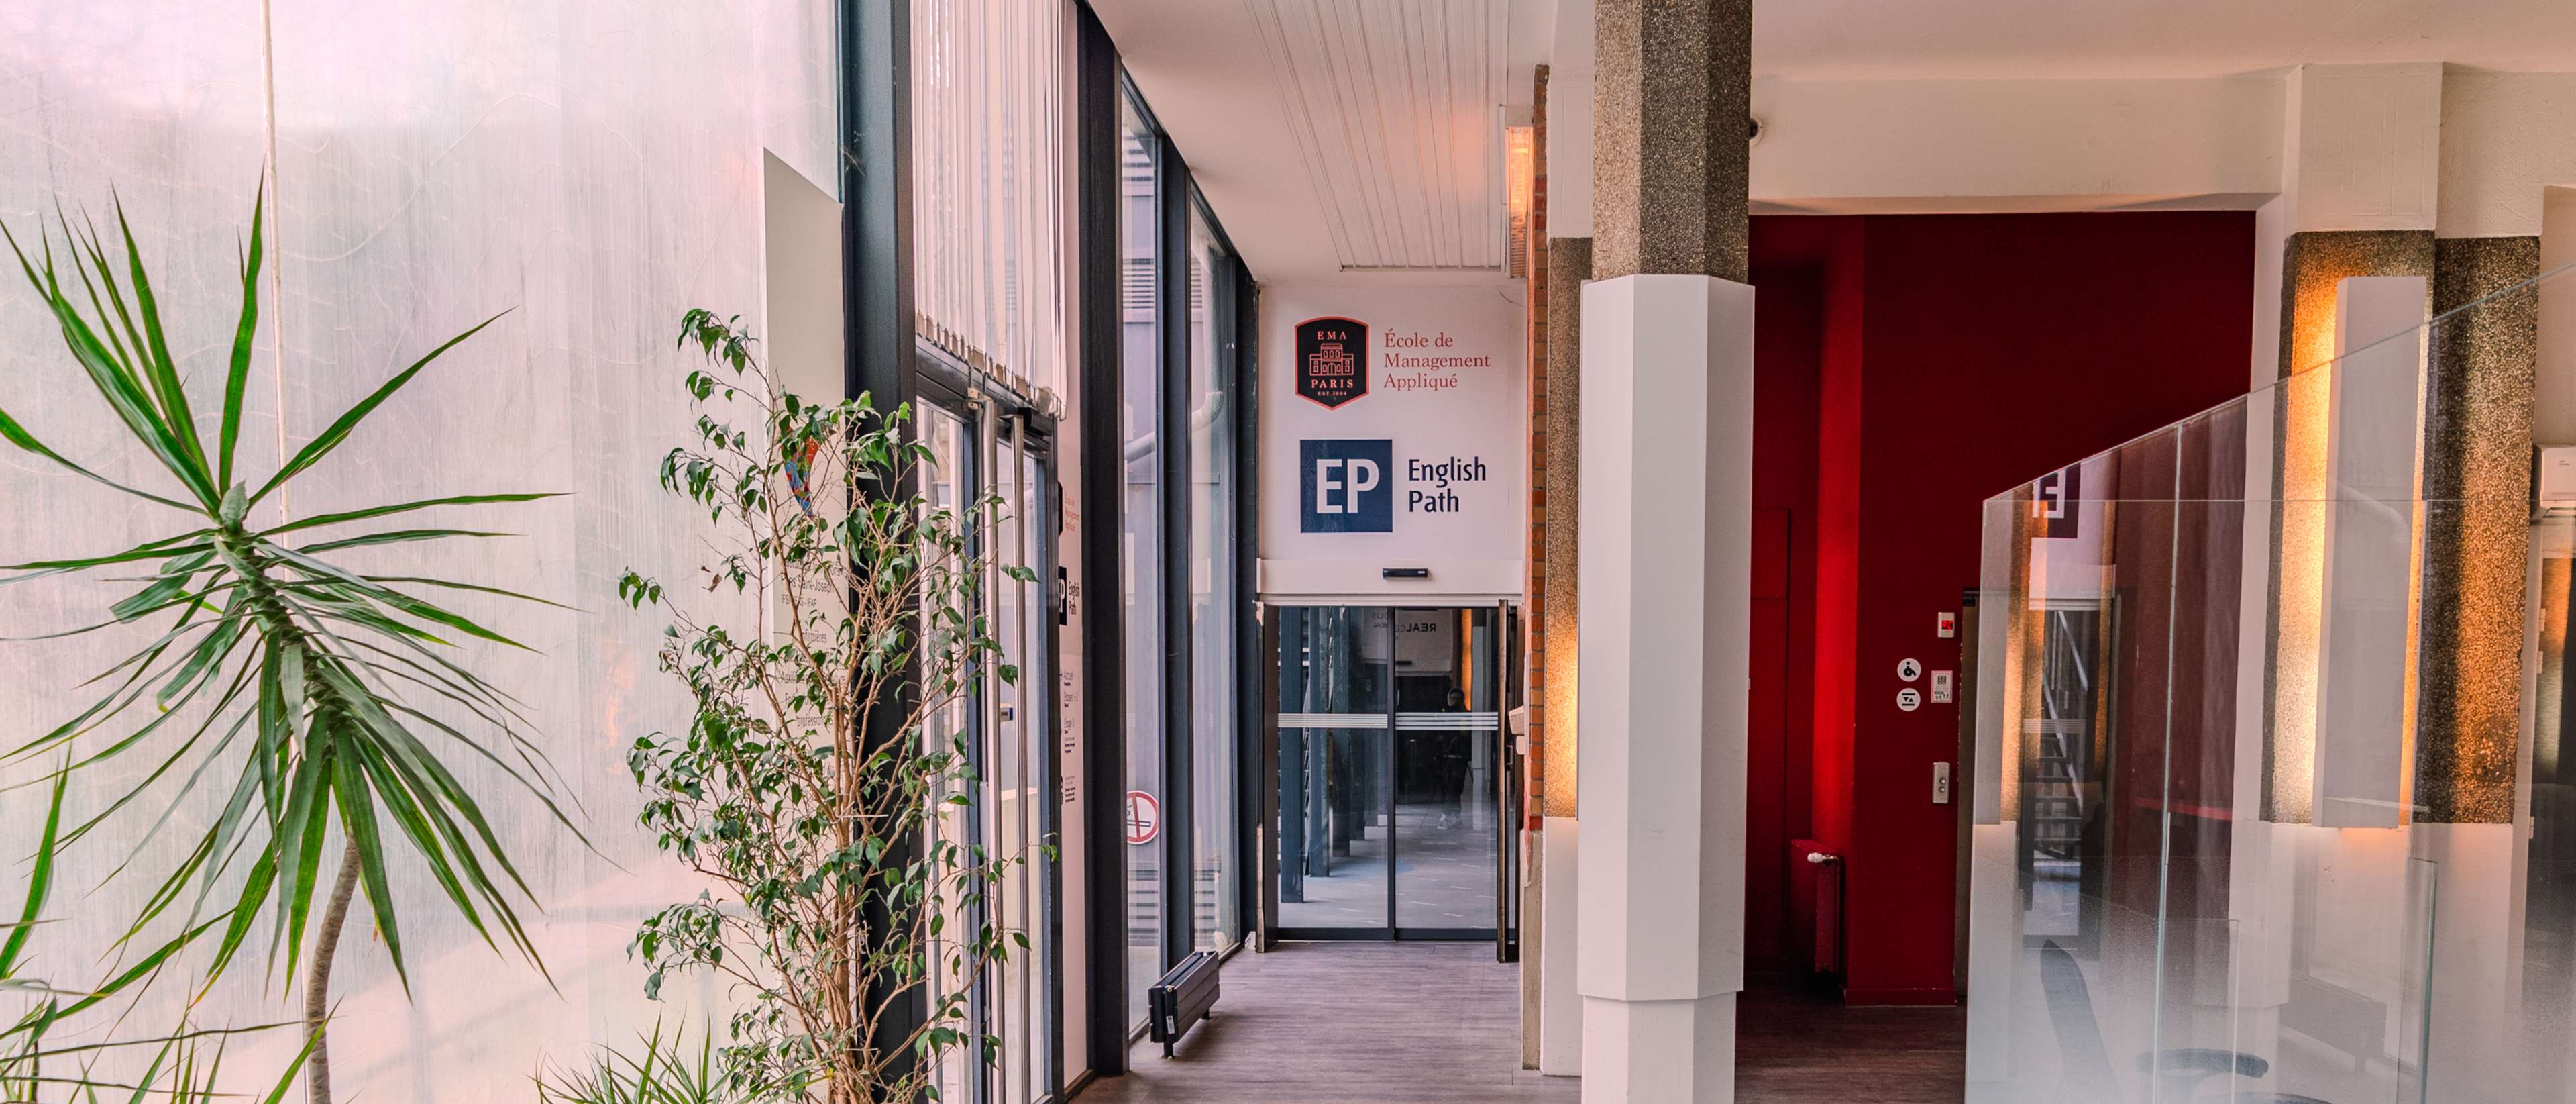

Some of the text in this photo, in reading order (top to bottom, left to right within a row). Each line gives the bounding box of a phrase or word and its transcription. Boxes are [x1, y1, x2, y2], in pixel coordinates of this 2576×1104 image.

[1317, 331, 1346, 340] EMA
[1384, 328, 1453, 348] École de
[1384, 353, 1491, 370] Management
[1311, 379, 1354, 388] PARIS
[1383, 373, 1458, 391] Appliqué
[1409, 456, 1487, 488] English
[1316, 459, 1379, 513] EP
[1409, 488, 1459, 513] Path
